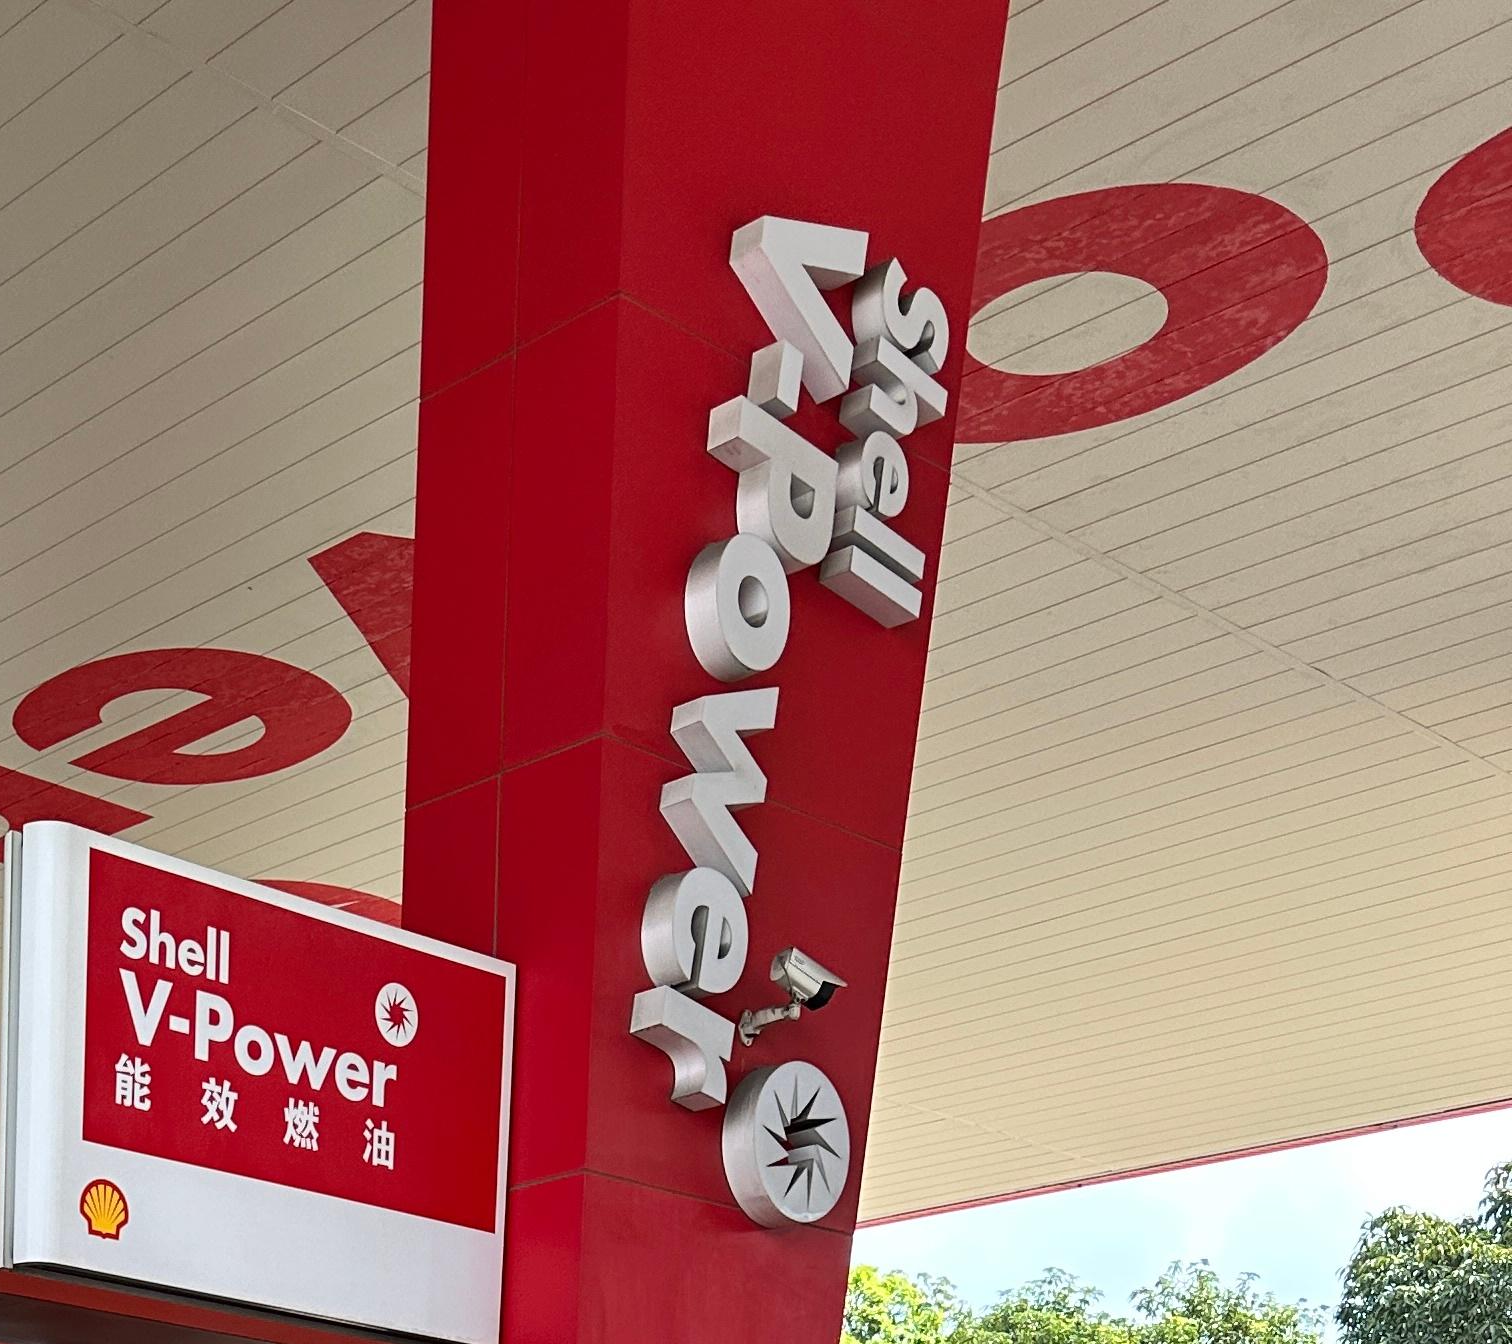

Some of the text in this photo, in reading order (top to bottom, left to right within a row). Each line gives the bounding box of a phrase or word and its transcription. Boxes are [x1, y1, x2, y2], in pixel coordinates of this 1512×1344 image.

[819, 256, 949, 628] Shell
[628, 214, 870, 1112] V-Power
[119, 906, 231, 985] Shell
[117, 967, 398, 1108] V-Power
[114, 1053, 396, 1171] 能效燃油
